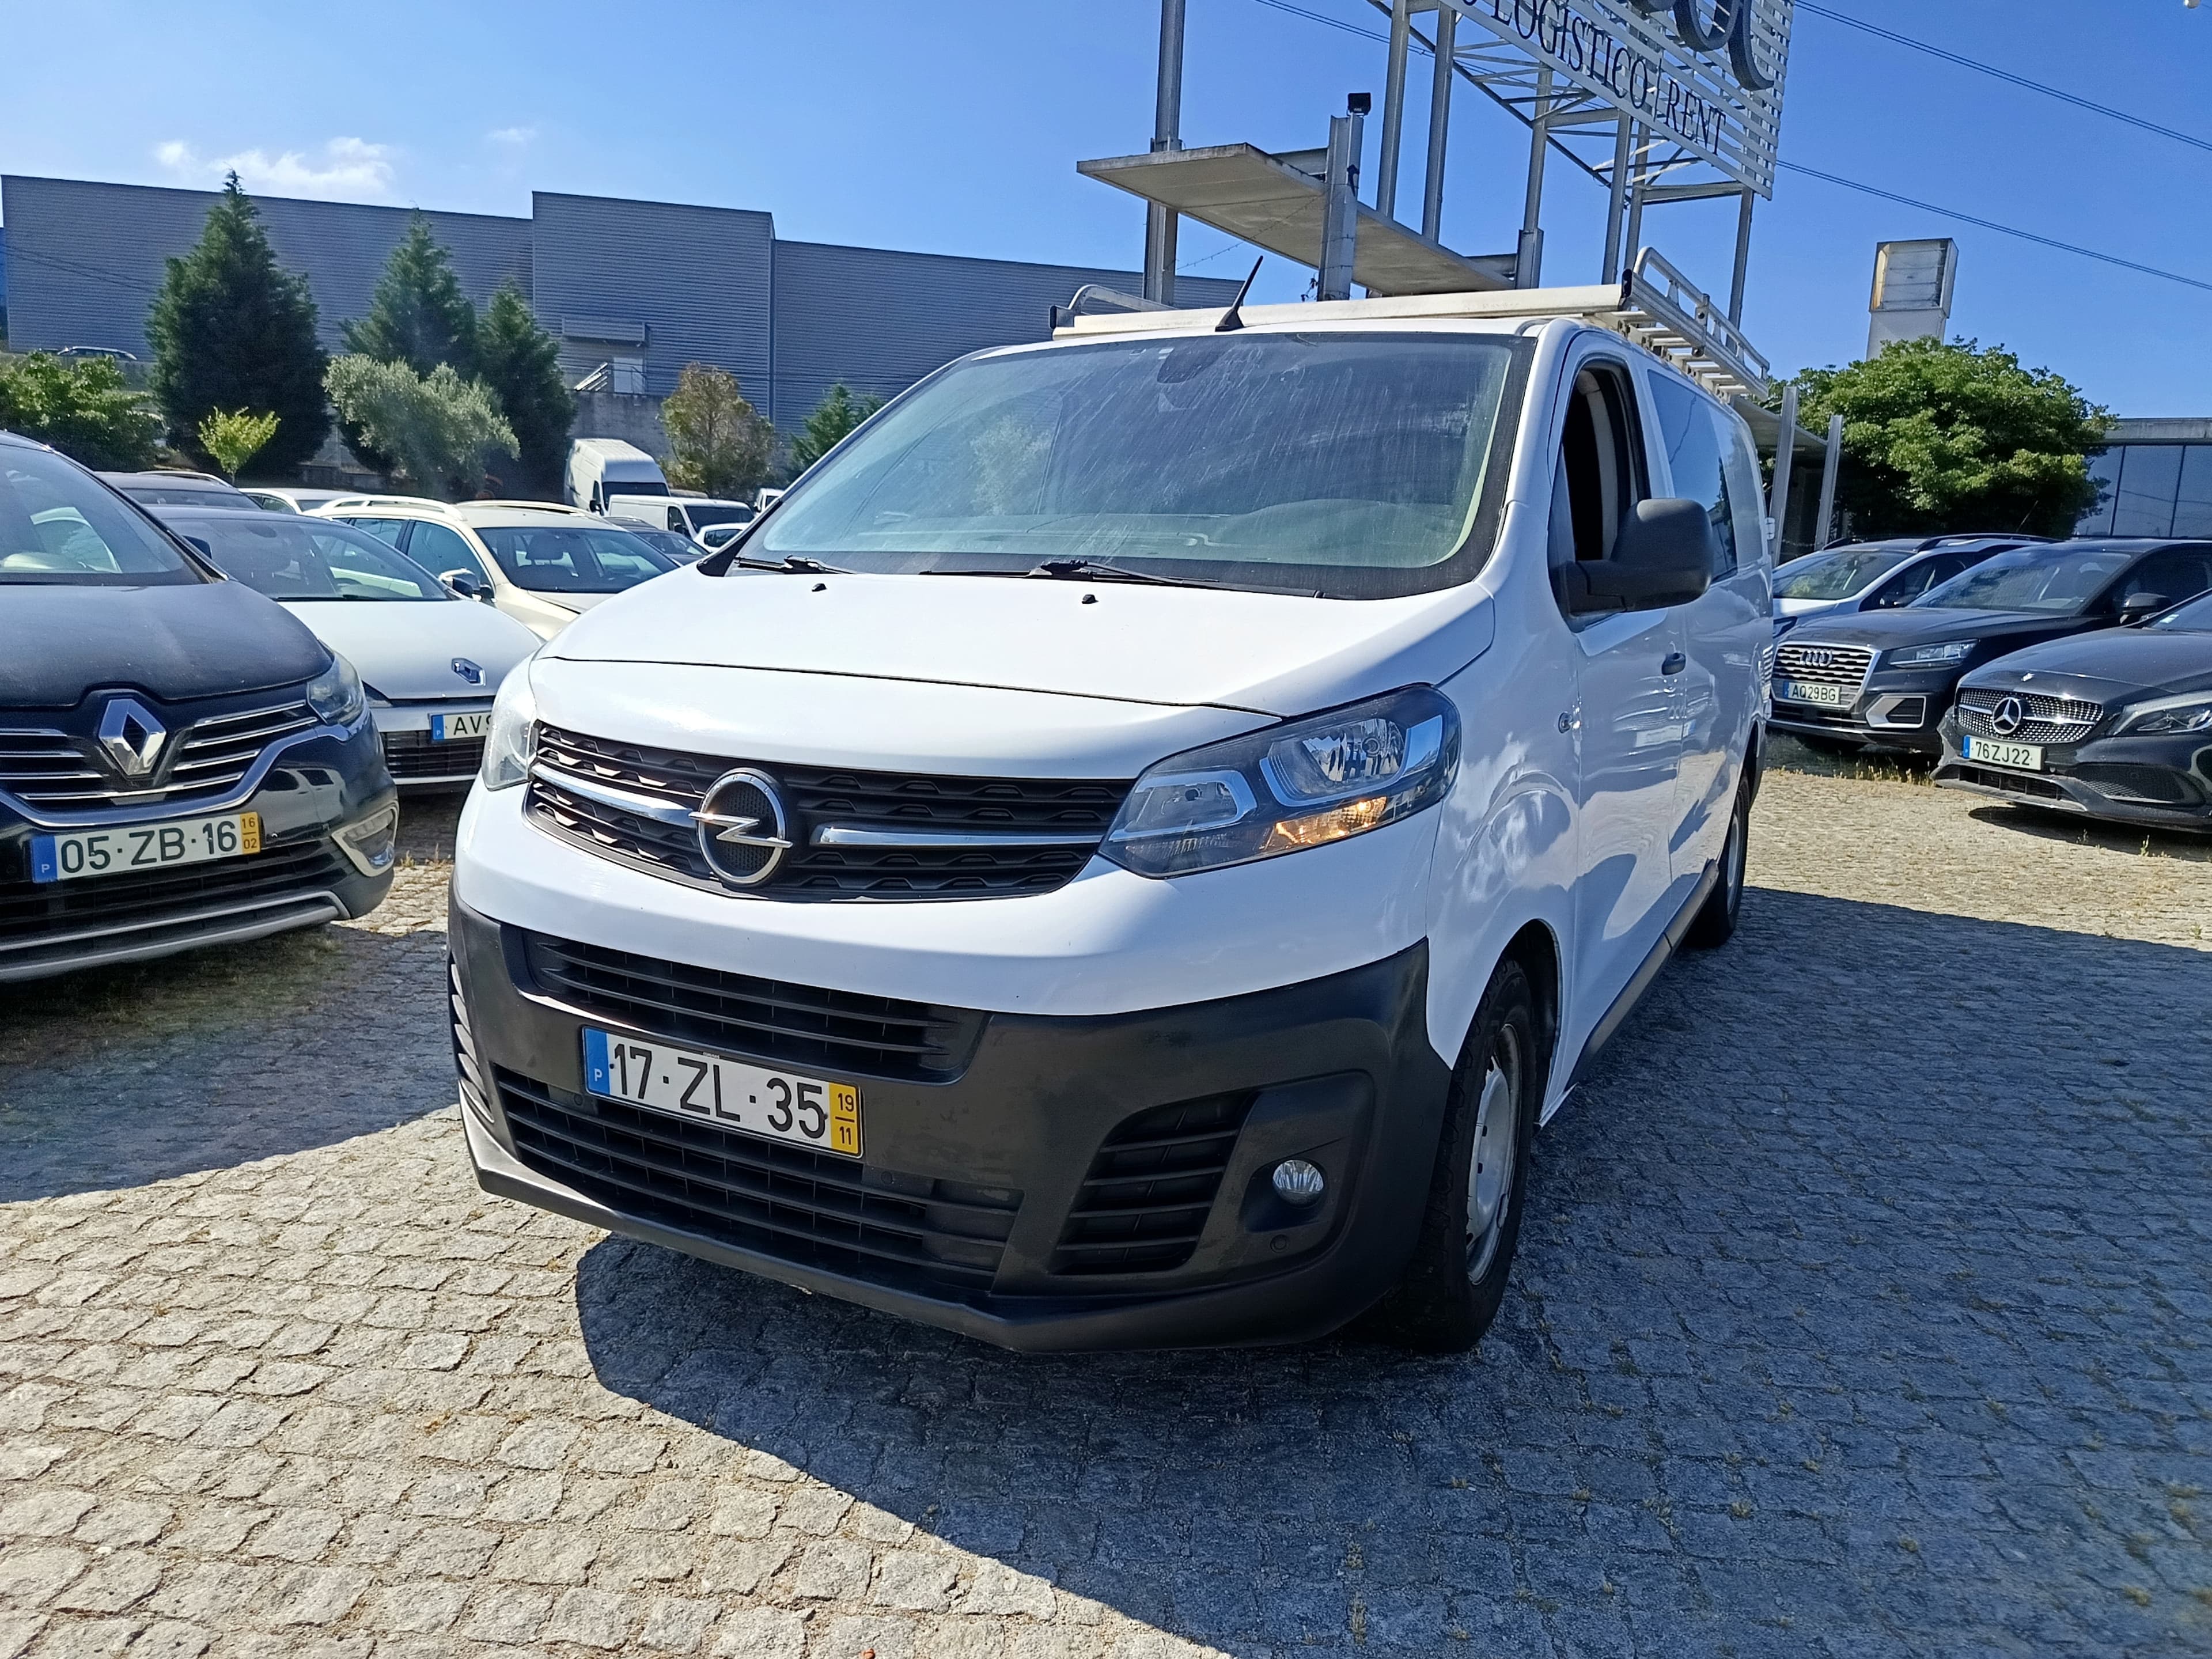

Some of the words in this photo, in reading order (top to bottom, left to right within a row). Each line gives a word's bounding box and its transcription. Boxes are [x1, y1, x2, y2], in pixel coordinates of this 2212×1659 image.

[1663, 77, 1726, 156] RENT
[1975, 741, 2030, 766] 76ZJ22
[241, 816, 255, 830] 16
[243, 838, 258, 850] 02
[40, 864, 50, 873] P
[594, 1068, 603, 1082] P
[838, 1092, 854, 1112] 19
[839, 1126, 851, 1146] 11
